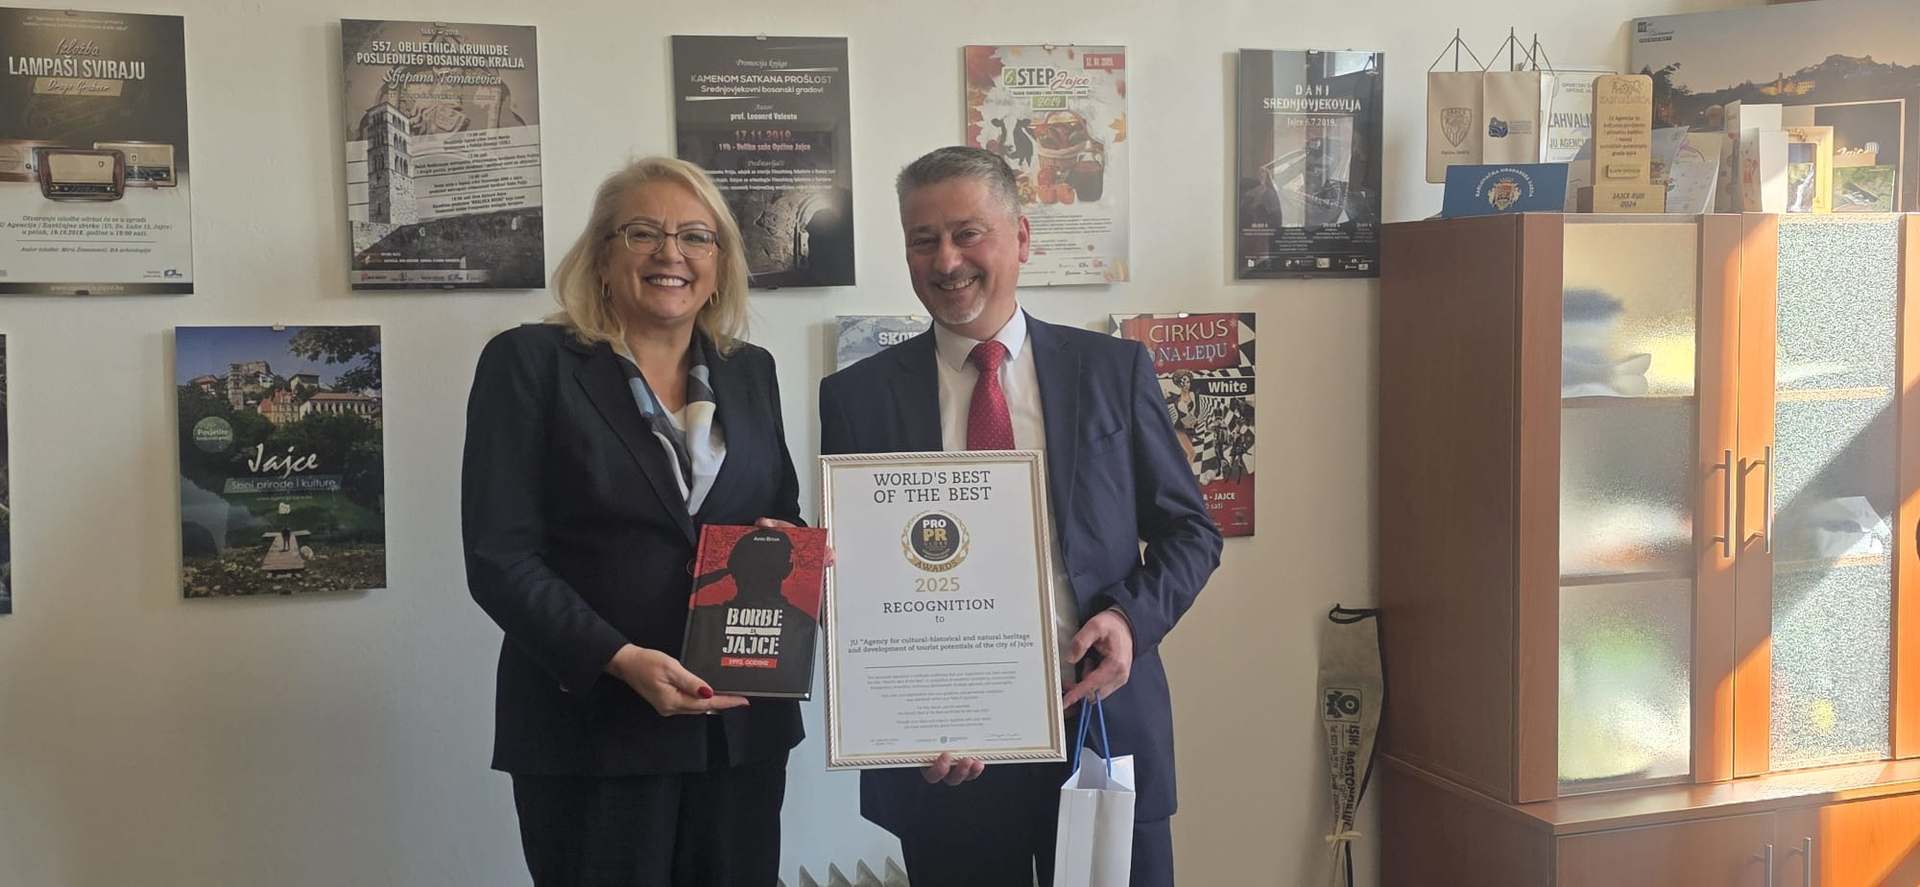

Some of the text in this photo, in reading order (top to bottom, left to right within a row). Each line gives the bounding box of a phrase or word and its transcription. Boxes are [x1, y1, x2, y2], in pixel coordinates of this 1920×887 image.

[372, 40, 509, 56] 557. OBLJETNICA KRUNIDBE
[9, 55, 146, 80] LAMPAŠI SVIRAJU
[357, 53, 525, 69] POSLJEDNJEG BOSANSKOG KRALJA
[691, 73, 832, 83] KAMENOM SATKANA PROŠLOST
[1018, 68, 1055, 85] STEP
[701, 85, 823, 96] Srednjovjekovni bosanski gradovi
[1295, 84, 1329, 96] DANI
[1263, 98, 1362, 112] SREDNJOVJEKOVLJA
[1149, 319, 1229, 343] CIRKUS
[1159, 343, 1228, 361] NA LEDU
[1208, 381, 1248, 393] White
[248, 443, 319, 480] Jajce
[874, 470, 992, 487] WORLD'S BEST
[874, 486, 992, 504] OF THE BEST
[922, 518, 948, 529] PRO
[923, 528, 948, 542] PR
[913, 559, 958, 573] AWARDS
[914, 577, 961, 593] 2025
[883, 598, 996, 614] RECOGNITION
[726, 607, 784, 627] BORBE
[935, 615, 945, 624] to
[722, 635, 780, 655] JAJCE
[890, 636, 900, 644] for
[962, 634, 977, 642] and
[977, 633, 1002, 641] natural
[1002, 632, 1031, 642] heritage
[848, 646, 862, 654] and
[863, 645, 907, 655] development
[908, 644, 916, 652] of
[916, 643, 939, 652] tourist
[940, 642, 974, 652] potentials
[974, 641, 983, 649] of
[983, 641, 994, 649] the
[995, 640, 1008, 650] city
[1009, 640, 1017, 648] of
